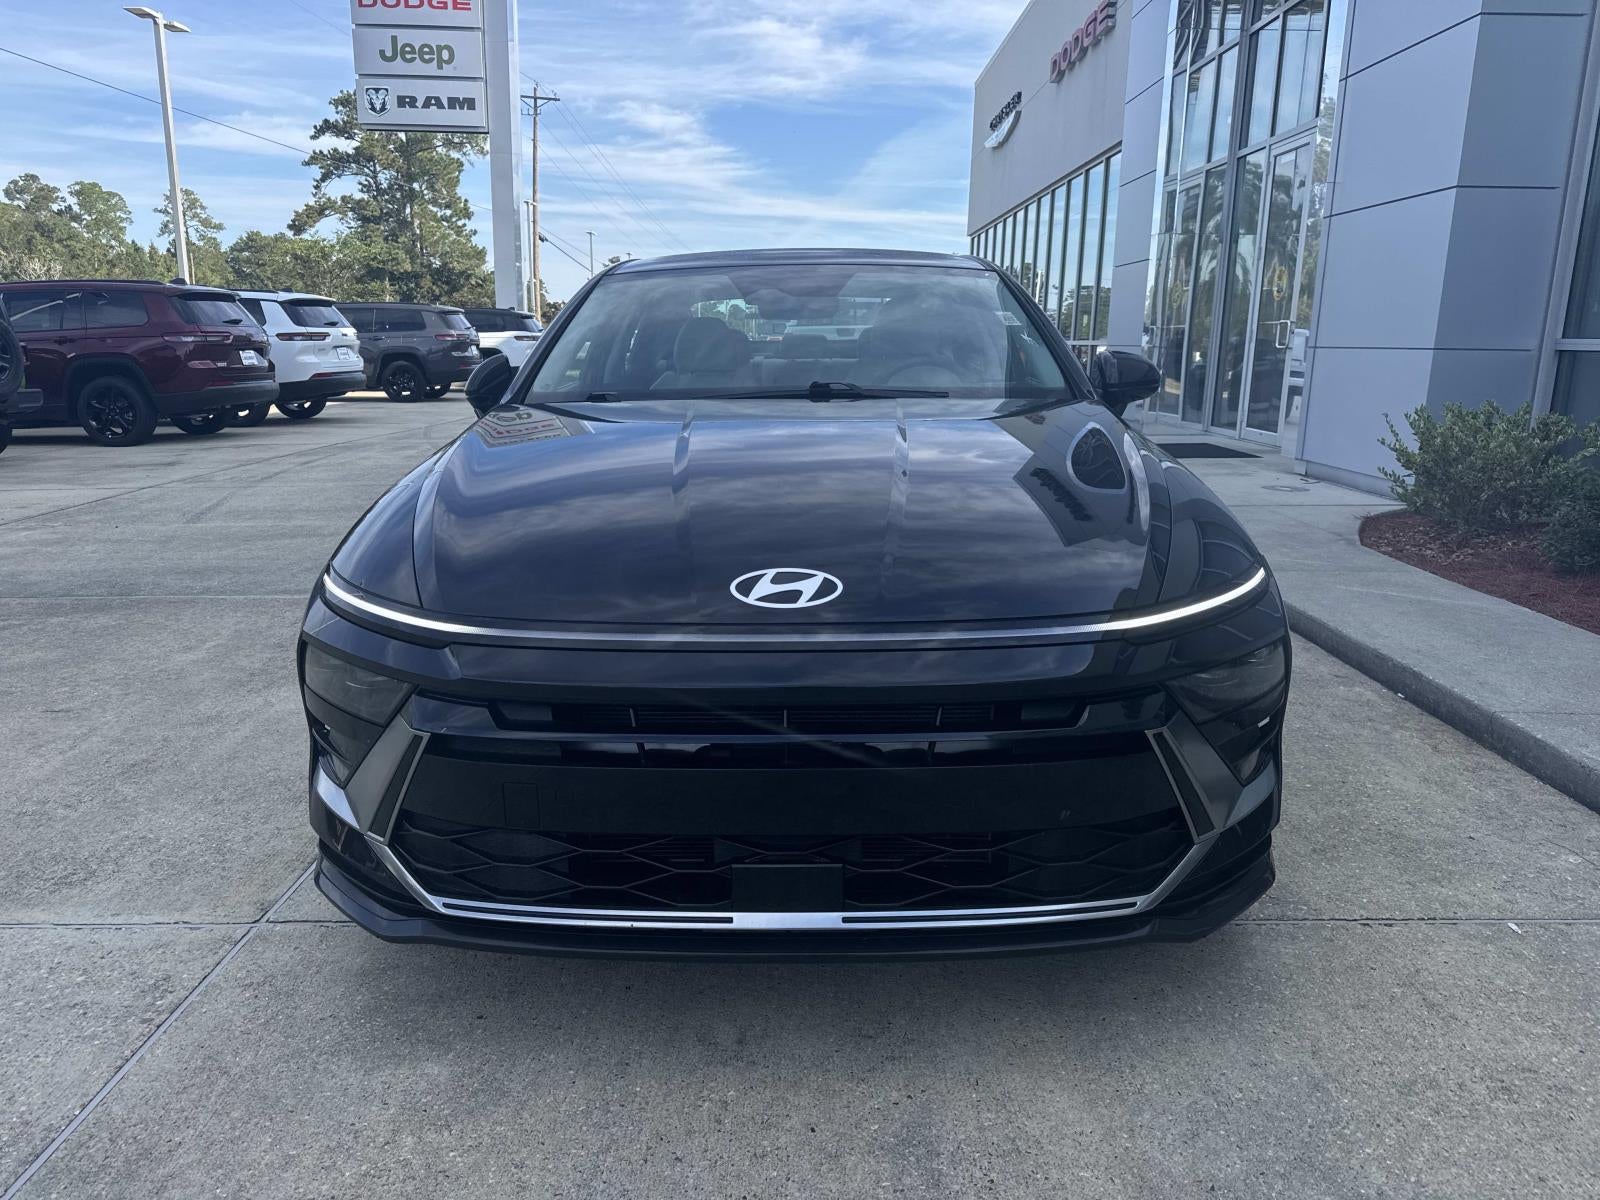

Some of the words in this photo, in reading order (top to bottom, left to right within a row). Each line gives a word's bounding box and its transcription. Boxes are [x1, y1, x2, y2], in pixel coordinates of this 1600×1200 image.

[378, 35, 455, 70] Jeep
[1050, 0, 1117, 83] DODGE
[396, 95, 476, 111] RAM
